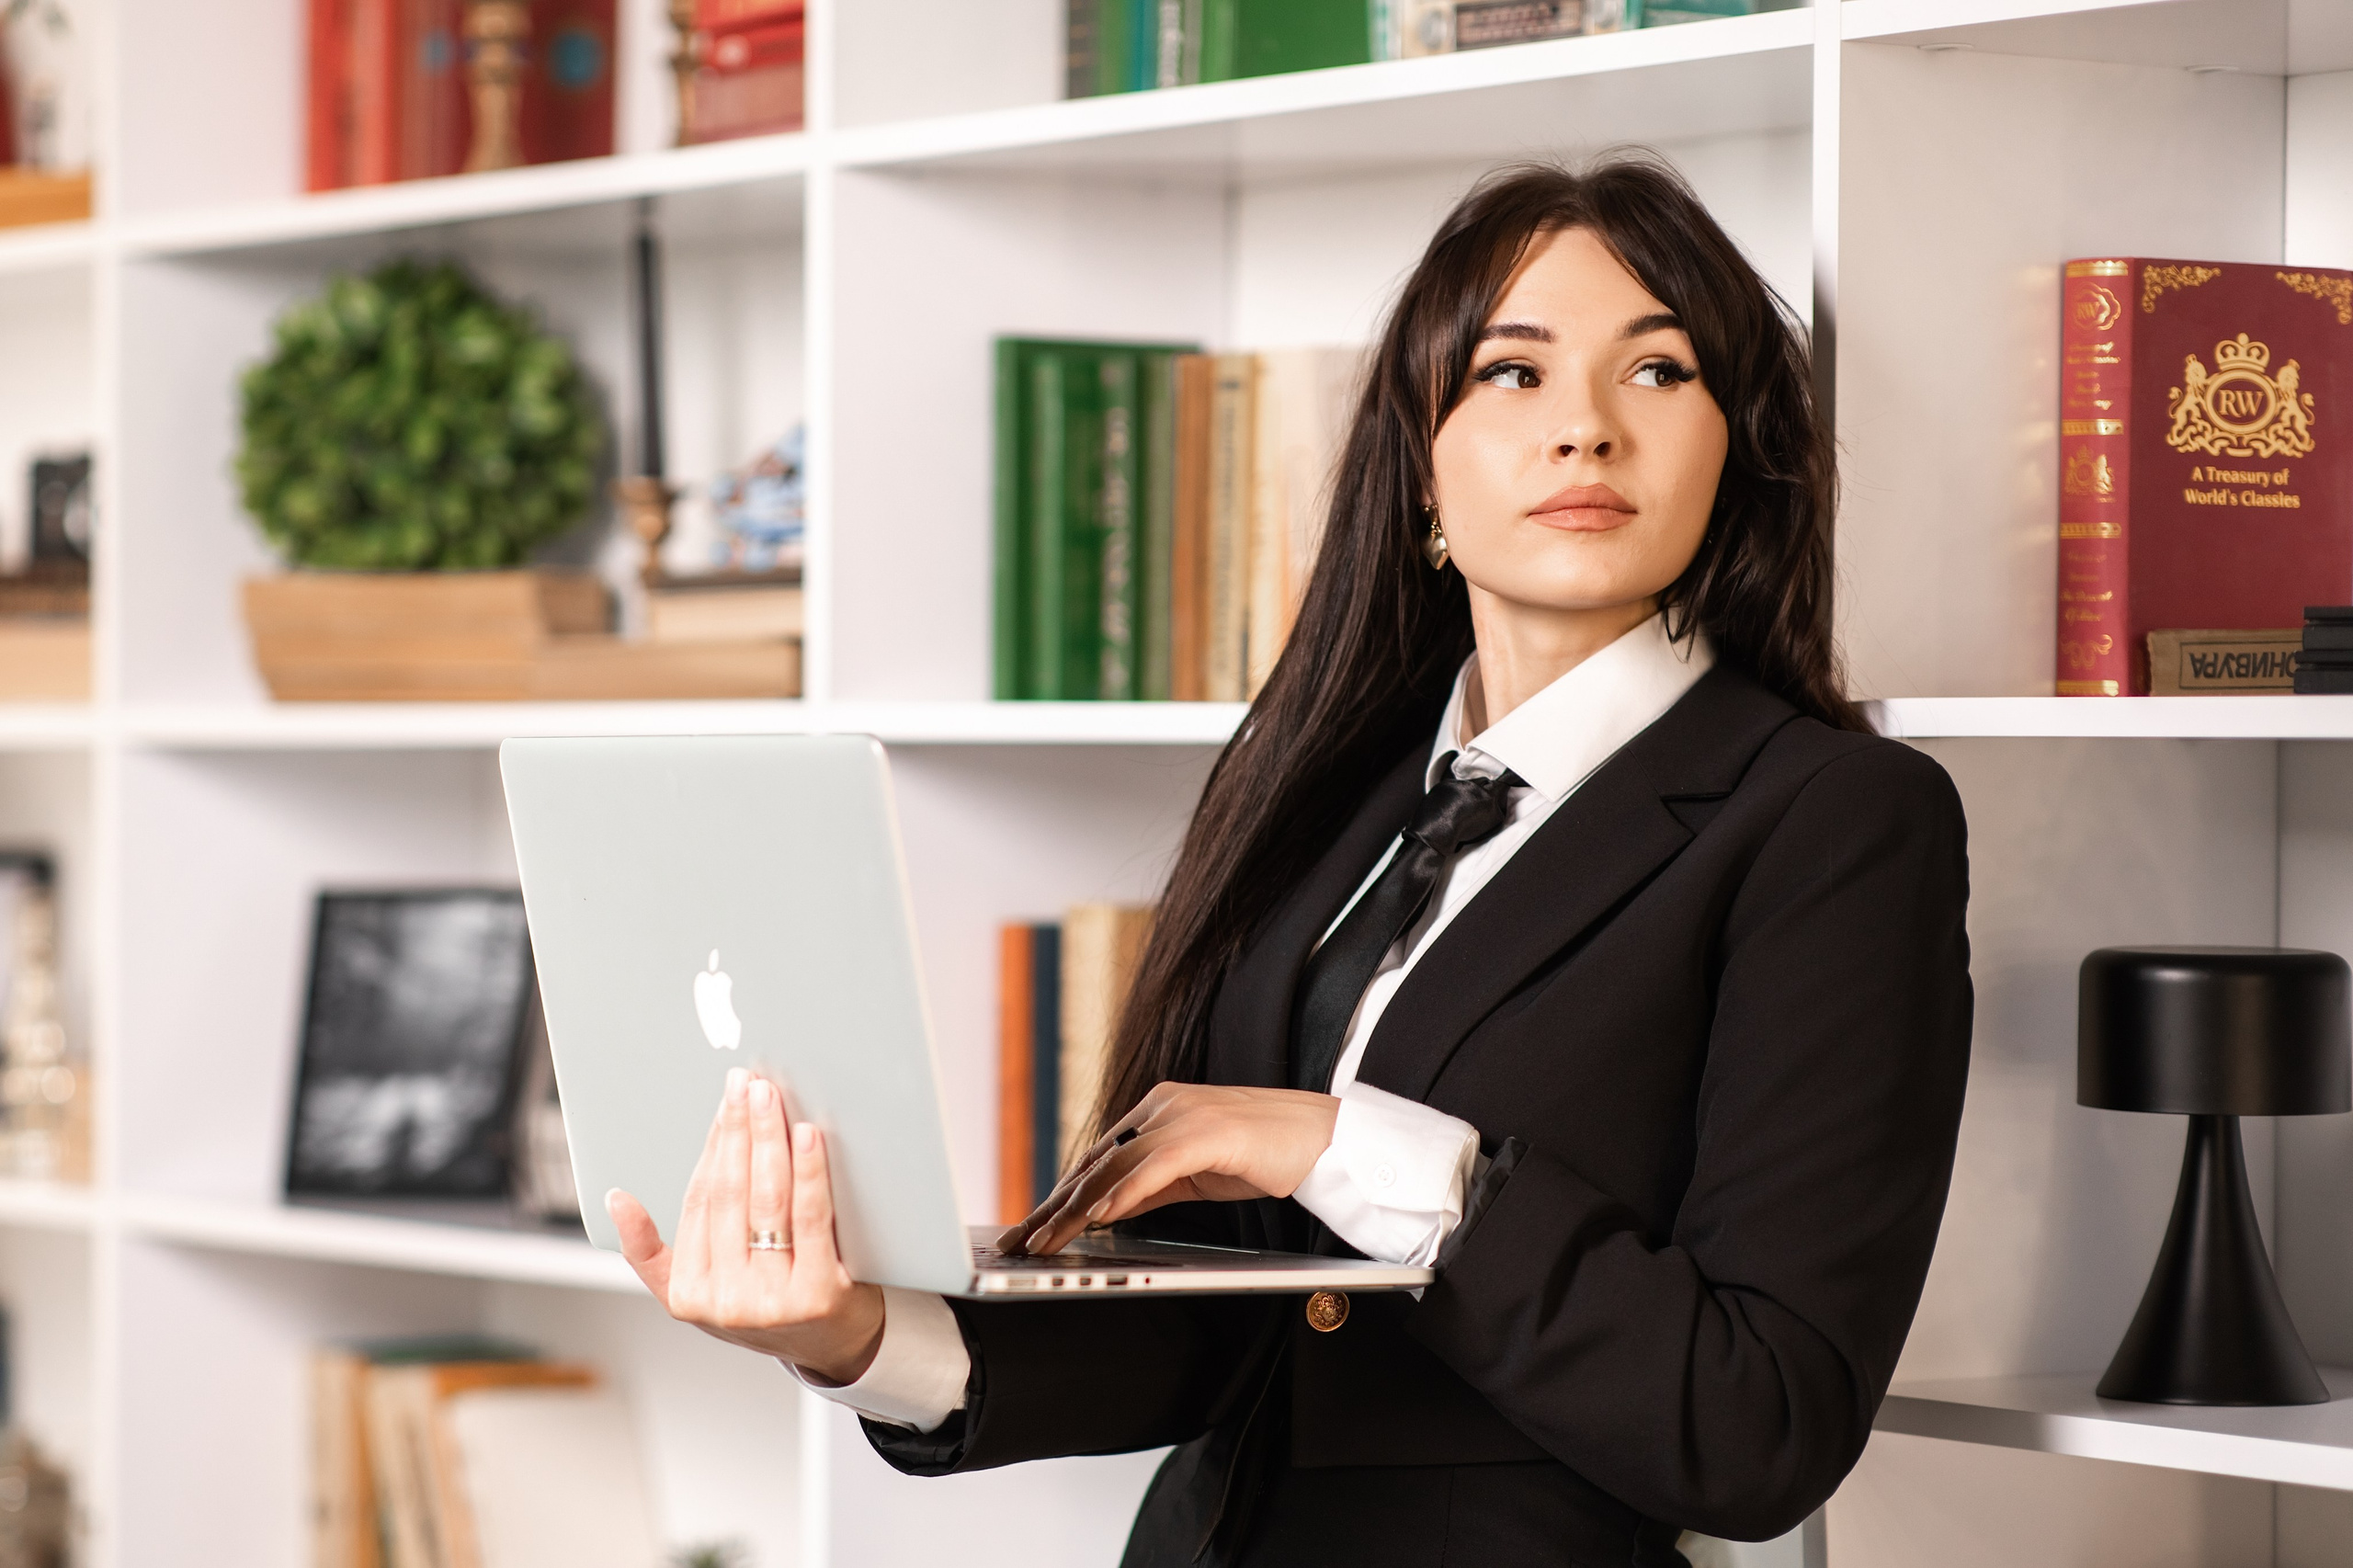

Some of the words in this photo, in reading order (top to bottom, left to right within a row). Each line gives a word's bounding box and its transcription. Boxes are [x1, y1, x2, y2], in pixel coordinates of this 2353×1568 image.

[2219, 389, 2264, 418] RW
[2191, 466, 2204, 482] A
[2206, 466, 2271, 488] Treasury
[2273, 468, 2290, 485] of
[2184, 488, 2238, 506] World's
[2240, 490, 2301, 508] Classics
